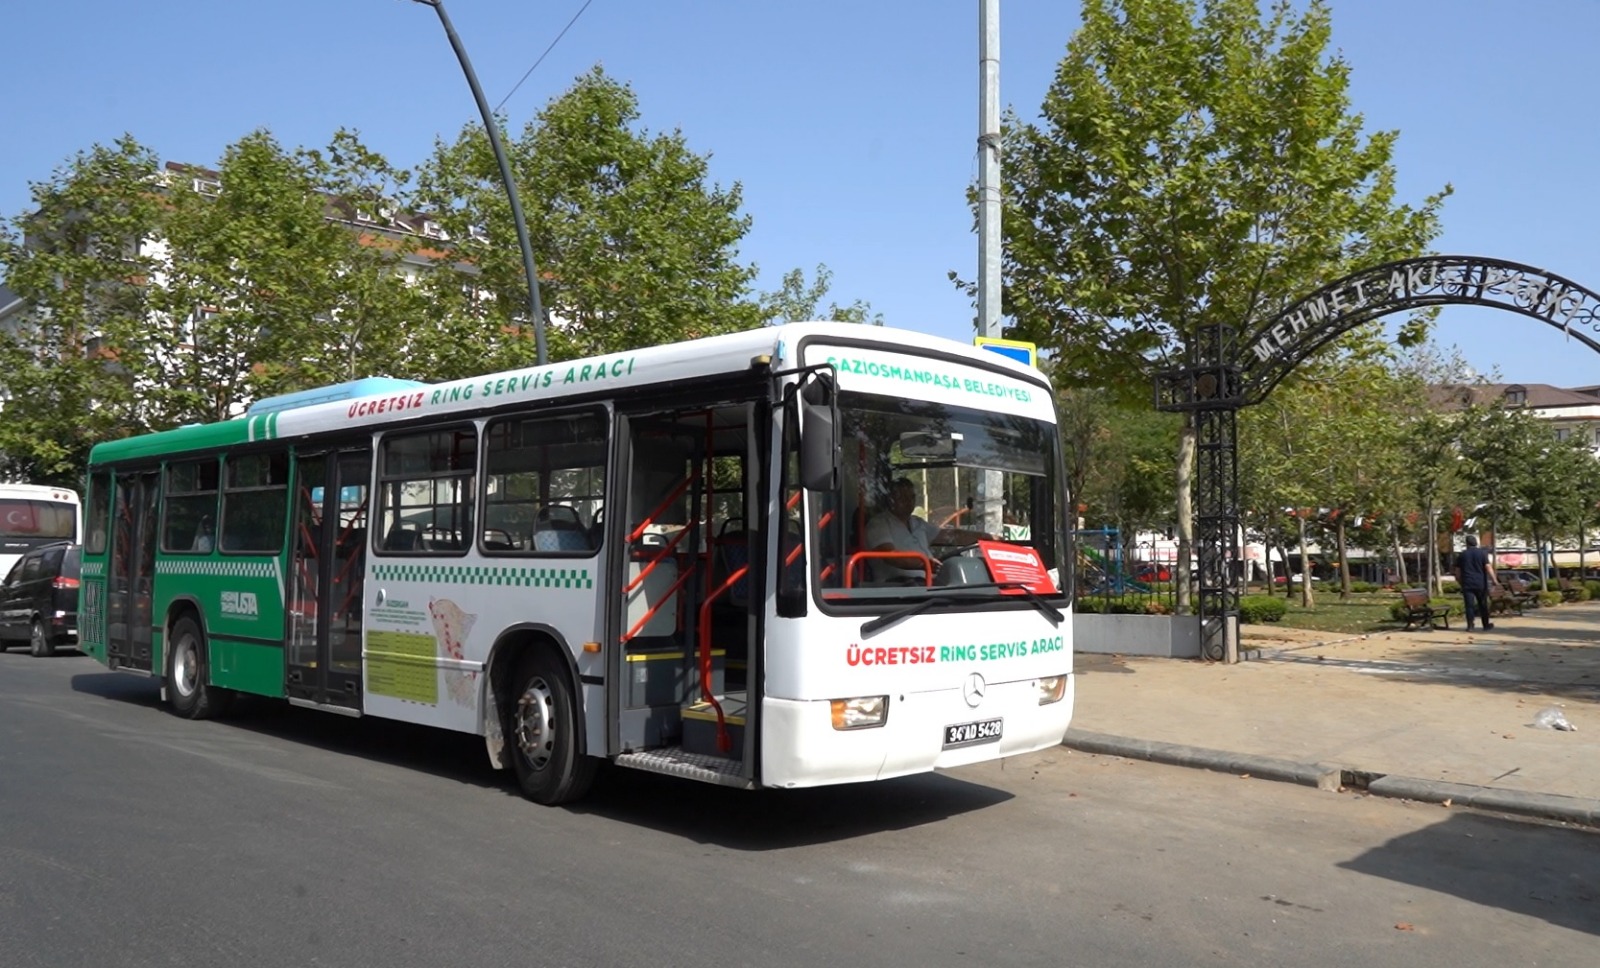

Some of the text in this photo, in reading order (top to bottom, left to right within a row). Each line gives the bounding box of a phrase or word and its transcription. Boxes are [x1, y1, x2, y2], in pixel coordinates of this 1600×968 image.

[1253, 280, 1366, 362] MEHMET
[563, 357, 635, 384] ARACI
[1031, 636, 1064, 655] ARACI
[949, 721, 1001, 743] 34 AD 5428
